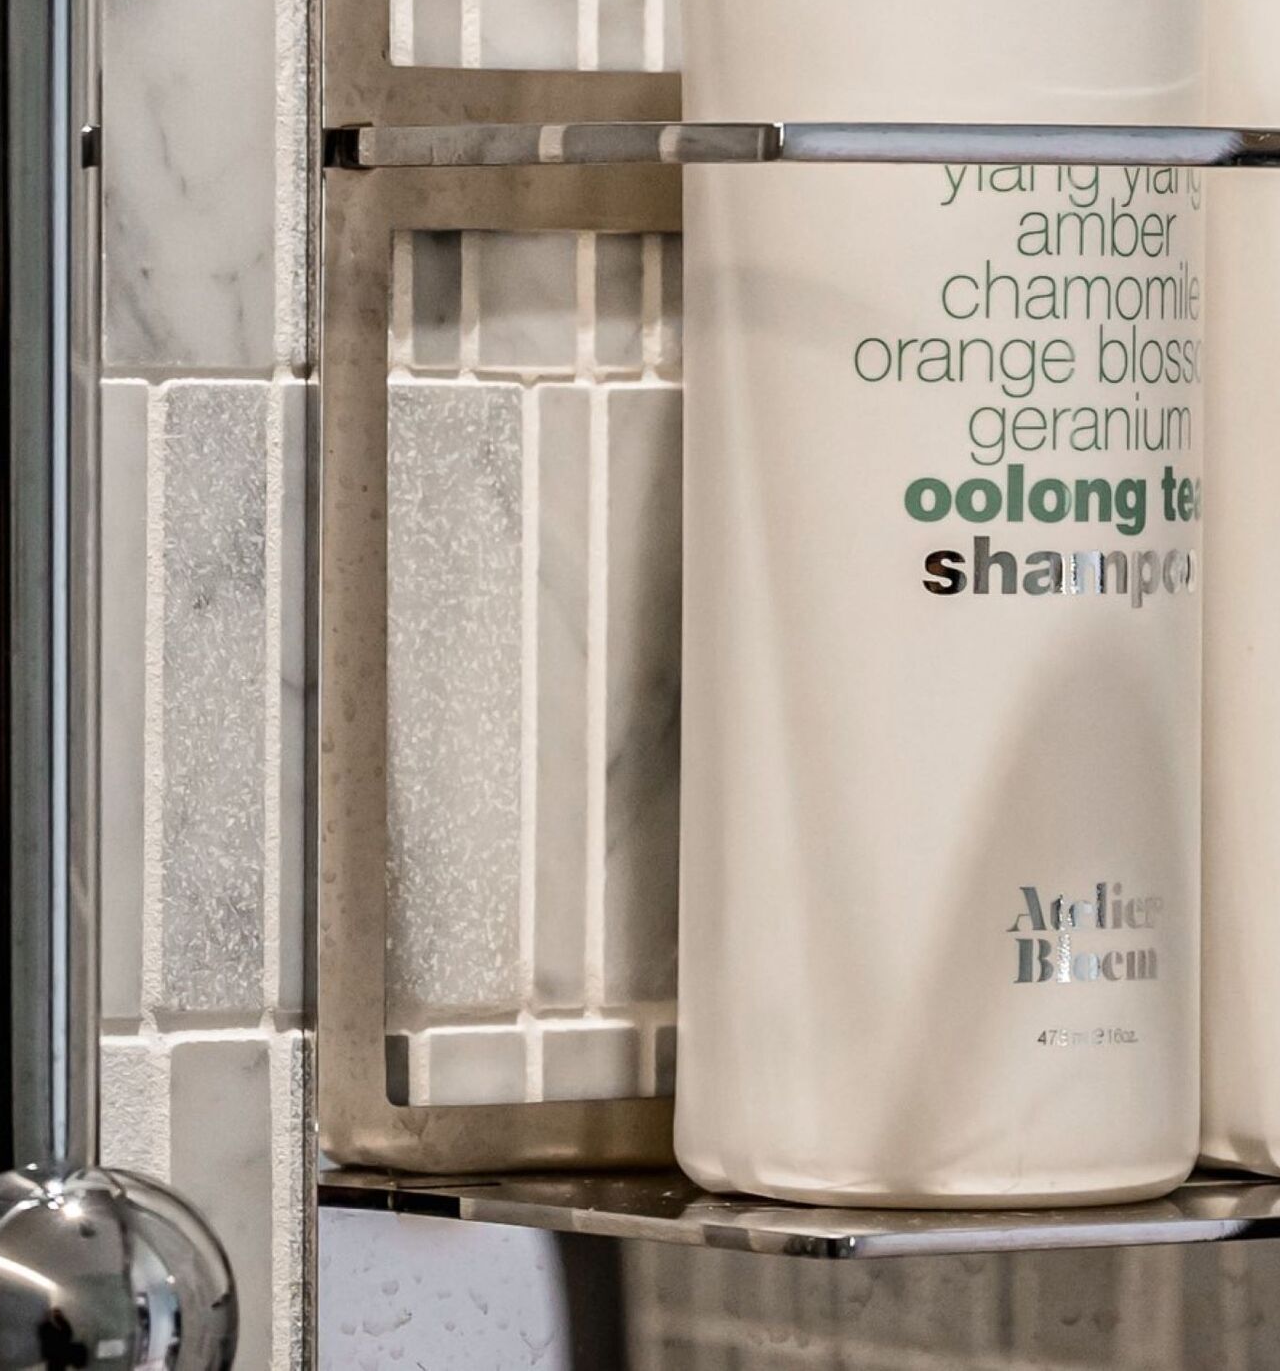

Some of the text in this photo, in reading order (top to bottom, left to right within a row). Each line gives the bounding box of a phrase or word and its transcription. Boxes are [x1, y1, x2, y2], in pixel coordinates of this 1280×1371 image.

[1017, 197, 1177, 257] amber
[941, 259, 1200, 321] chamomile
[854, 337, 1075, 398] orange
[969, 392, 1192, 466] geranium
[904, 463, 1147, 536] oolong
